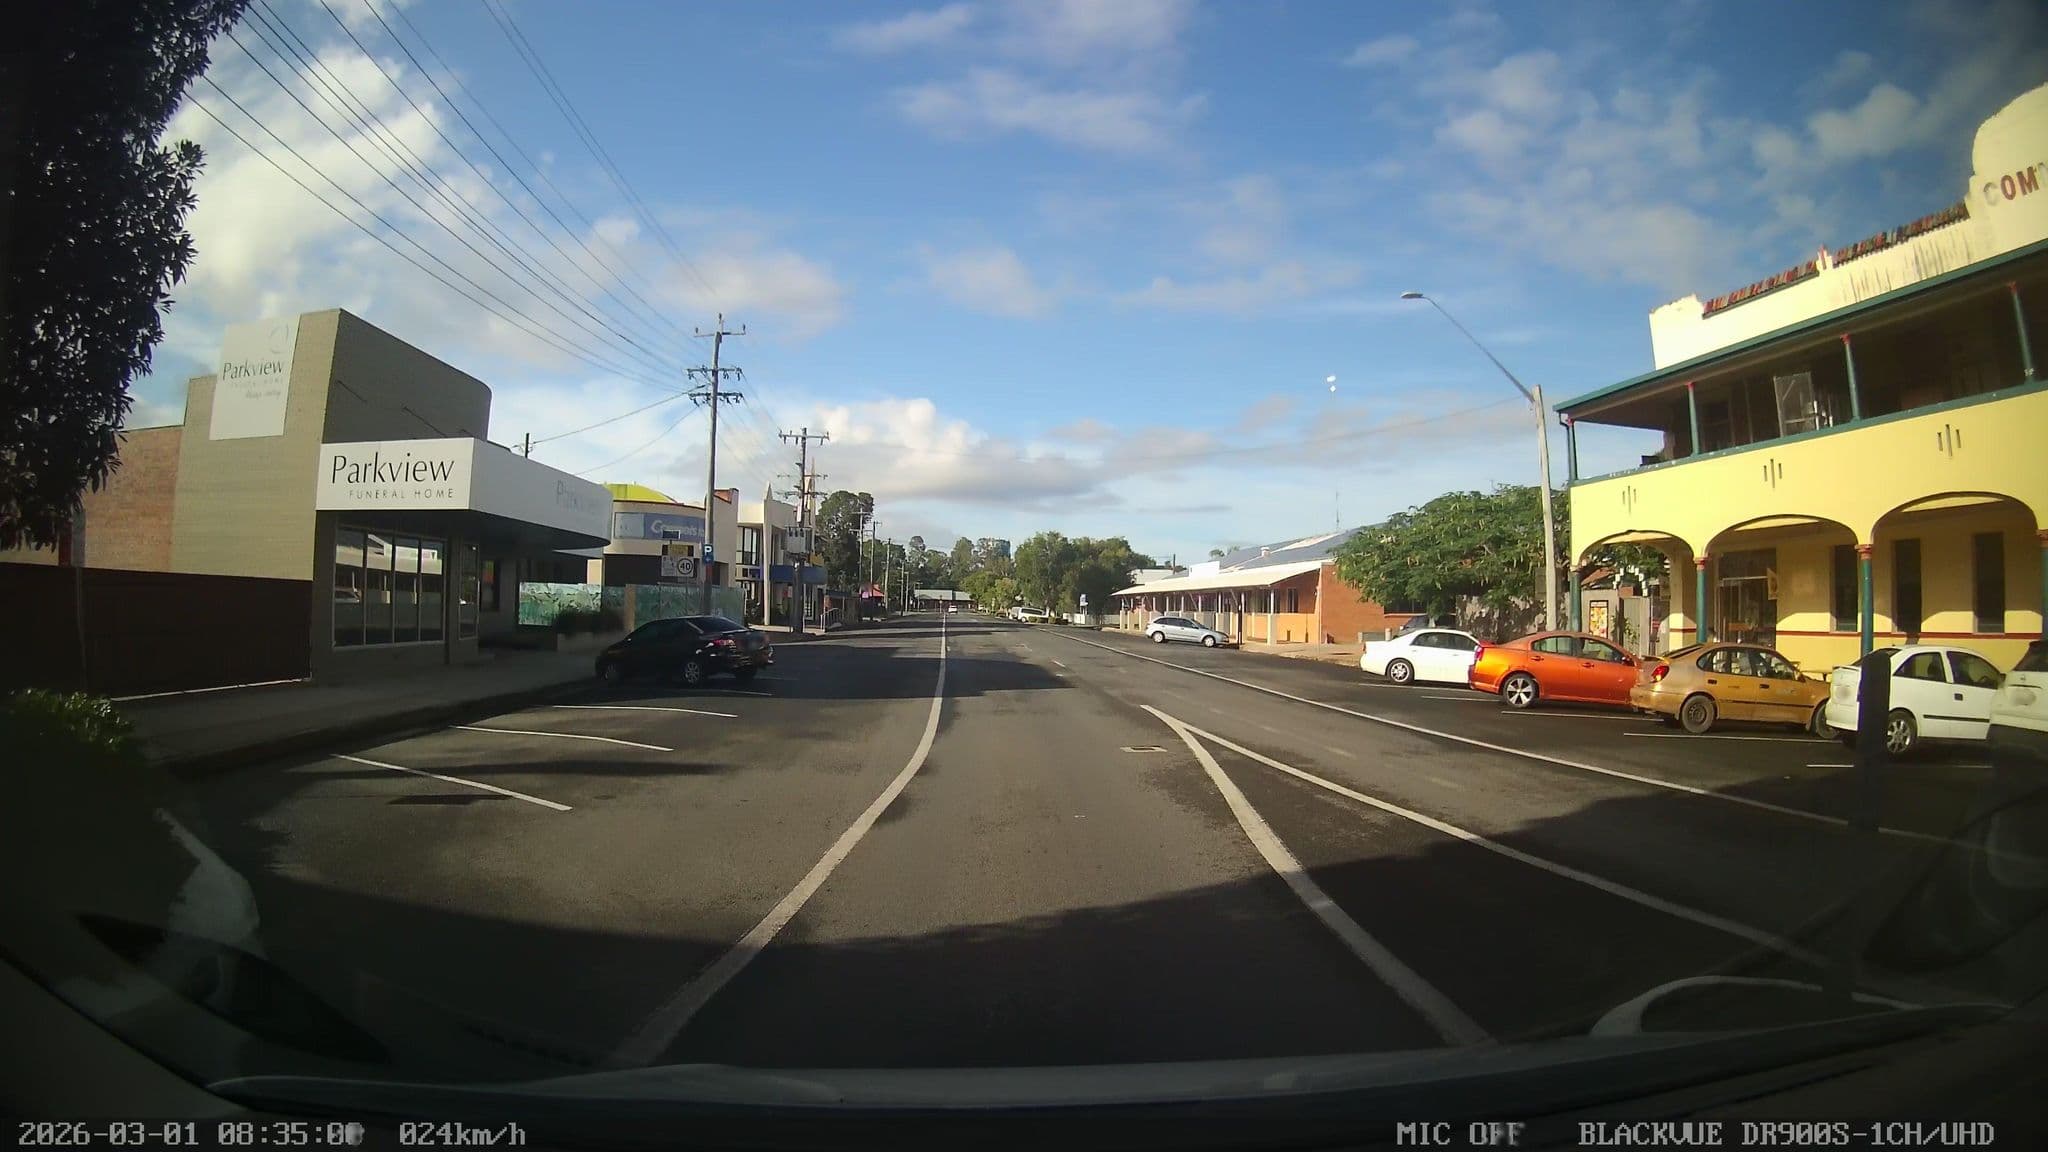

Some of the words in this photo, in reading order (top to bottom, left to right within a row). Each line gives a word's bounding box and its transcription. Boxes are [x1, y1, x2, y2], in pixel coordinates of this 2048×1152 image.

[222, 358, 284, 380] Parkview
[332, 451, 455, 484] Parkview
[349, 488, 405, 500] FUNERAL
[414, 488, 454, 499] HOME
[704, 545, 712, 556] P
[679, 562, 691, 571] 40
